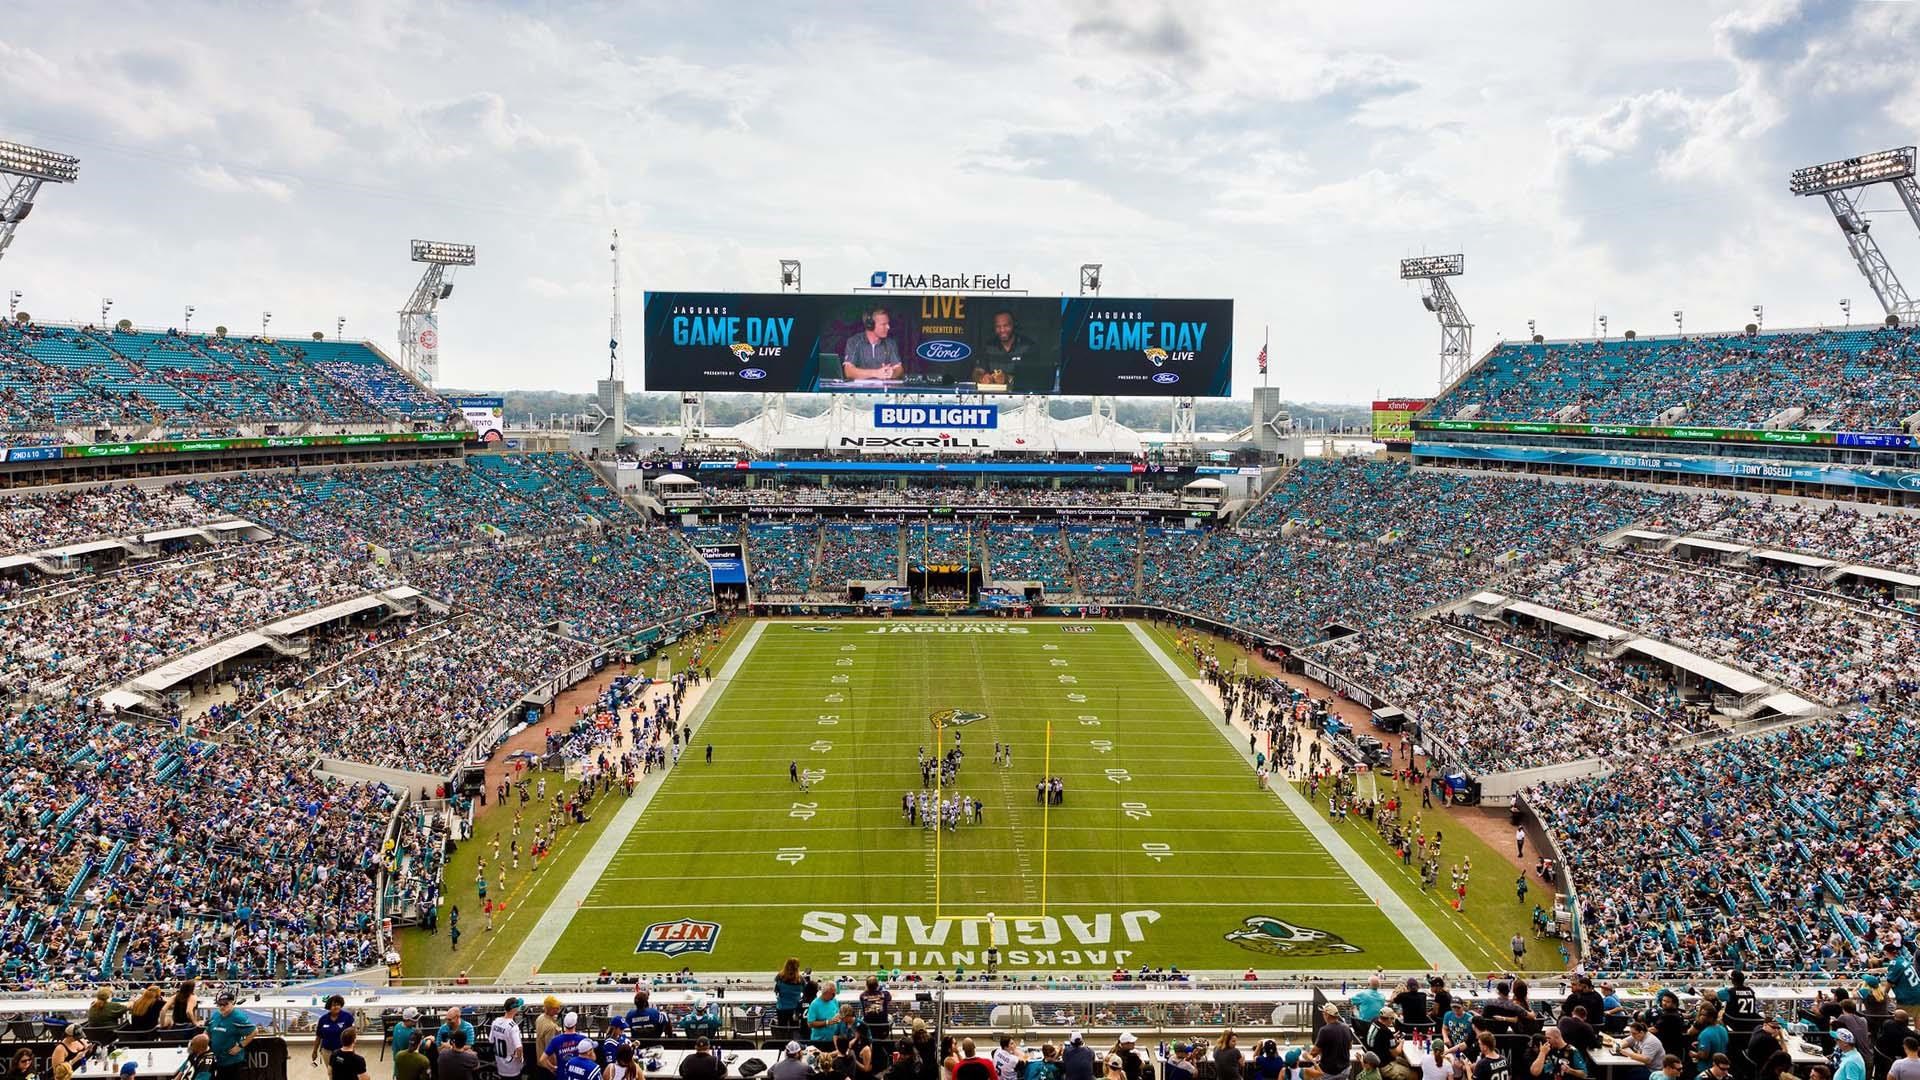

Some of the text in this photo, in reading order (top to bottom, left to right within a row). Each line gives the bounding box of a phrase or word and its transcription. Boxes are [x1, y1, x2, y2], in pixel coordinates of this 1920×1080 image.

[889, 273, 1010, 289] TIAA Bank Field
[673, 306, 727, 315] JAGUARS
[921, 296, 966, 319] LIVE
[1089, 312, 1142, 320] JAGUARS
[673, 316, 794, 347] GAME DAY
[922, 326, 953, 334] PRESENTED
[1088, 321, 1207, 351] GAME DAY
[758, 347, 781, 357] LIVE
[927, 342, 960, 359] Ford
[1172, 352, 1195, 361] LIVE
[1387, 402, 1410, 410] xfinity
[881, 408, 991, 425] BUD LIGHT
[840, 434, 990, 447] NEXGRILL
[1621, 457, 1636, 466] FRED
[1637, 458, 1661, 468] TAYLOR
[1742, 465, 1762, 475] TONY
[1762, 466, 1792, 478] BOSELLI
[865, 626, 1030, 634] JAGUARS
[817, 715, 840, 725] 50
[1078, 715, 1101, 726] 50
[1104, 768, 1132, 782] 30
[789, 802, 818, 817] 20
[1121, 802, 1153, 817] 20
[776, 846, 807, 861] 10
[1141, 842, 1175, 857] 10
[654, 923, 713, 941] NFL
[800, 910, 1162, 946] JAGUARS
[837, 950, 1133, 967] JACKSONVILLE
[1737, 998, 1754, 1014] 27
